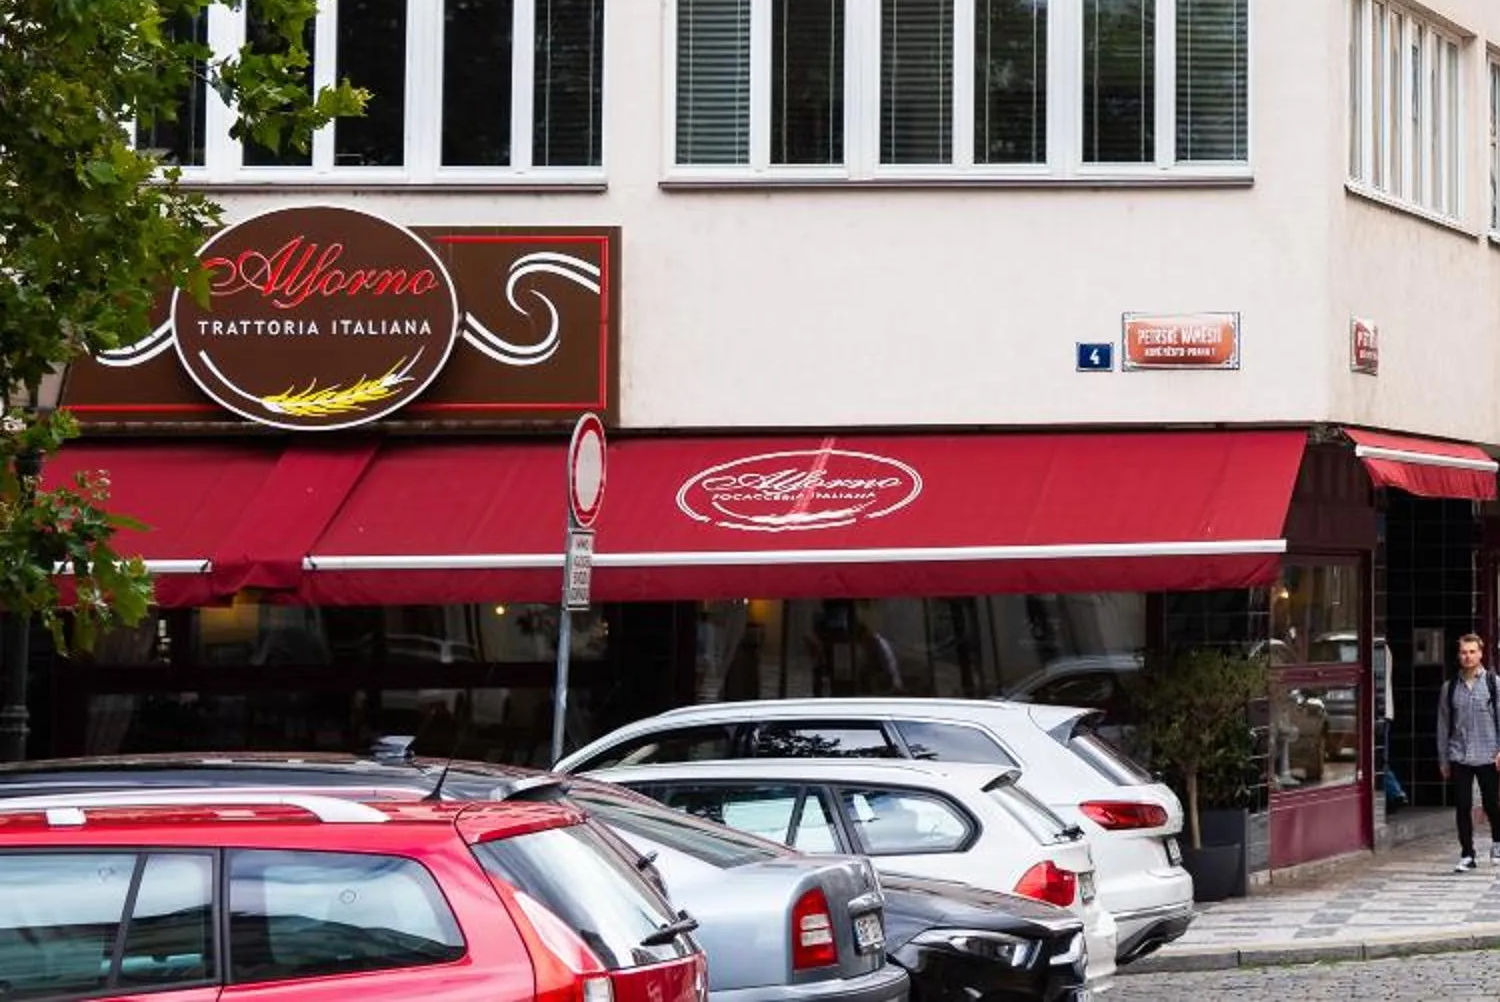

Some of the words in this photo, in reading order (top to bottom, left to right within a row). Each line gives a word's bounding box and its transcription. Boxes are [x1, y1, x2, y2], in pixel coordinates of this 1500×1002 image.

[202, 235, 438, 309] Alforno
[198, 321, 320, 336] TRATTORIA
[332, 320, 432, 335] ITALIANA
[1089, 349, 1100, 365] 4
